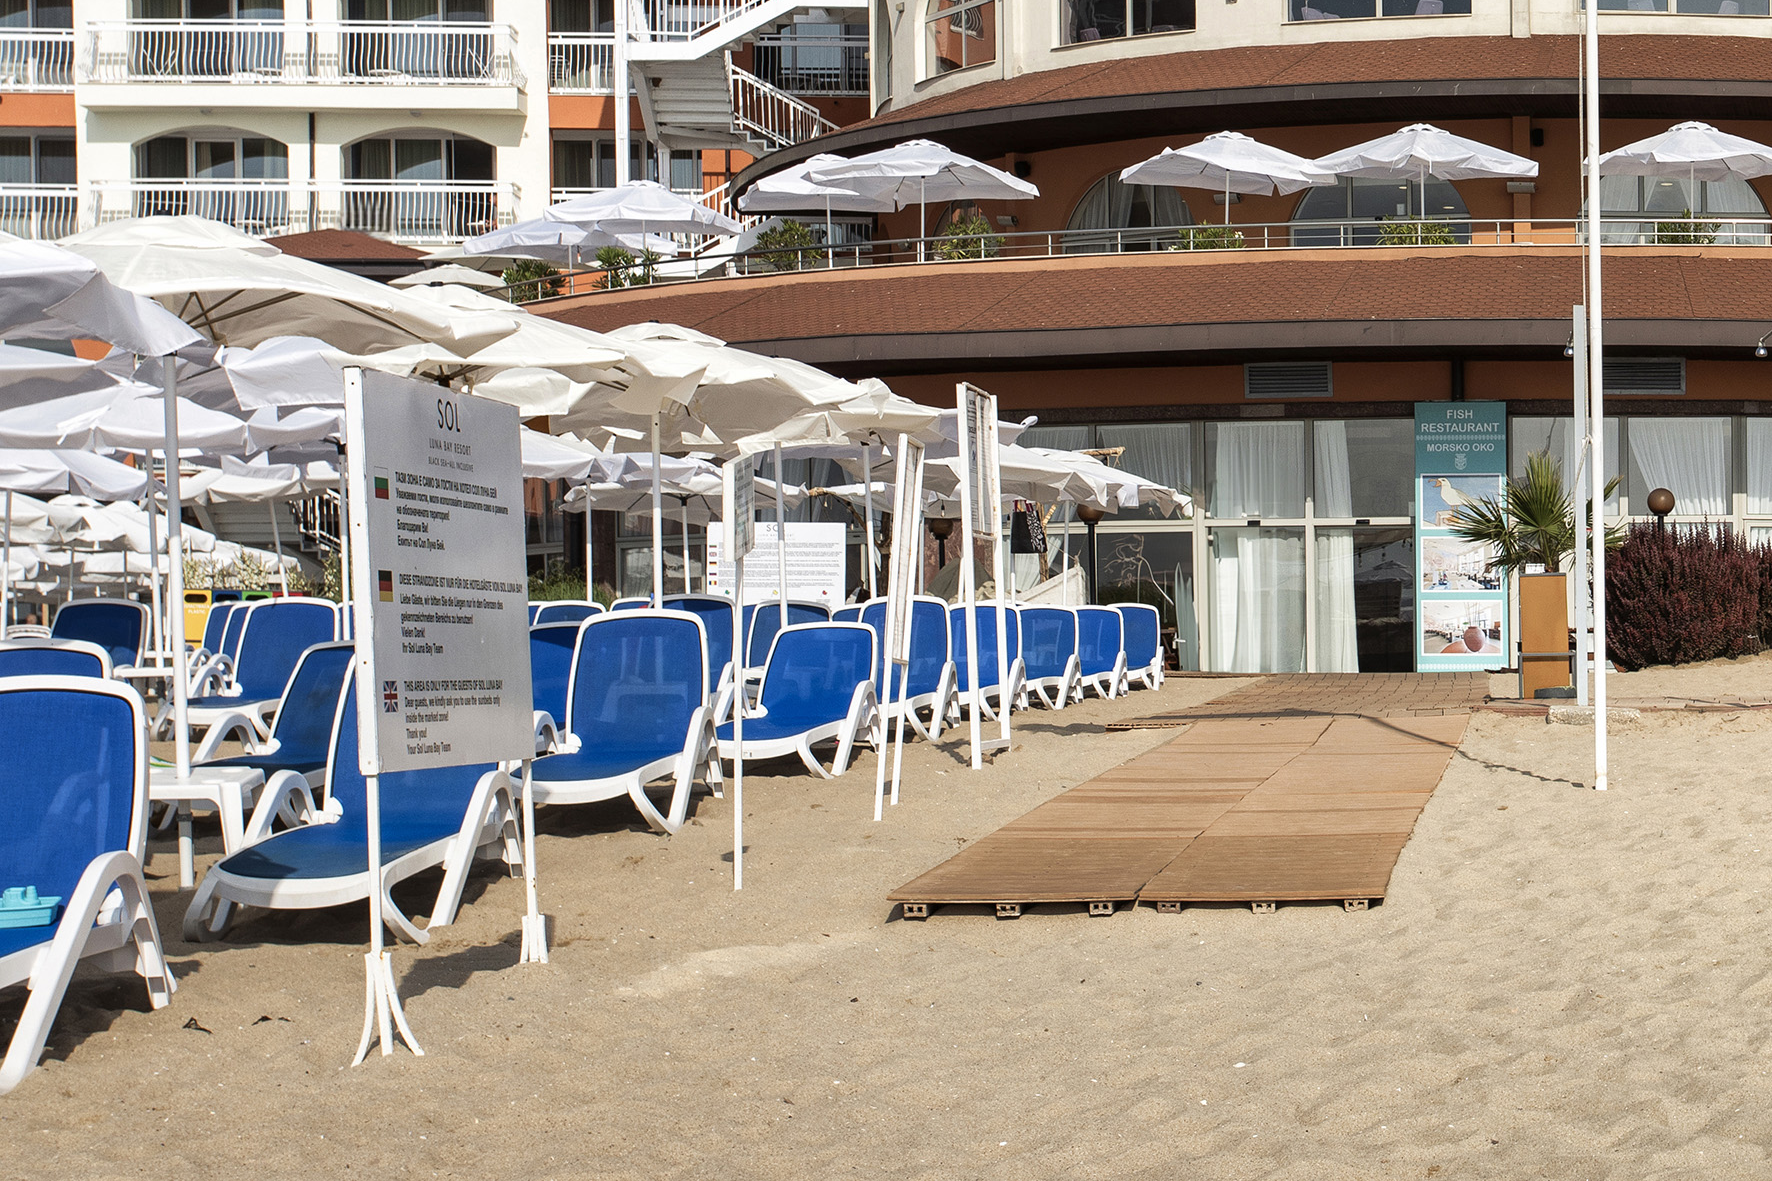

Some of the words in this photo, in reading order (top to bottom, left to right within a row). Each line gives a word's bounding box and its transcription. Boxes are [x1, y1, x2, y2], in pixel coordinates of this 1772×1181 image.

[437, 399, 460, 432] SOL
[1447, 410, 1473, 419] FISH
[1421, 423, 1499, 432] RESTAURANT
[429, 438, 442, 450] LUNA
[444, 441, 453, 452] BAY
[454, 443, 471, 456] RESORT
[1427, 443, 1470, 452] MORSKO
[1473, 443, 1494, 452] OKO
[428, 456, 439, 465] BLACK
[395, 472, 406, 483] ТАЗИ
[407, 474, 419, 485] ЗОНА
[423, 476, 434, 488] САМО
[399, 573, 411, 585] DIESE
[412, 575, 439, 587] STRANDZONE
[446, 578, 454, 588] NUR
[400, 593, 411, 604] Liebe
[431, 596, 441, 606] bitten
[454, 597, 466, 610] Liegen
[483, 600, 496, 610] Grenzen
[435, 612, 451, 623] Bereichs
[402, 627, 413, 637] Vielen
[416, 643, 425, 653] Luna
[433, 643, 443, 653] Team
[404, 680, 413, 691] THIS
[414, 680, 425, 691] AREA
[430, 680, 441, 691] ONLY
[441, 680, 449, 691] FOR
[458, 680, 472, 691] GUESTS
[486, 680, 495, 690] LUNA
[405, 697, 414, 707] Dear
[415, 697, 428, 709] guests,
[435, 696, 445, 708] kindly
[478, 695, 492, 705] sunbeds
[405, 713, 417, 723] inside
[425, 712, 438, 722] marked
[406, 729, 418, 739] Thank
[407, 744, 416, 754] Your
[424, 743, 433, 753] Luna
[441, 742, 451, 752] Team
